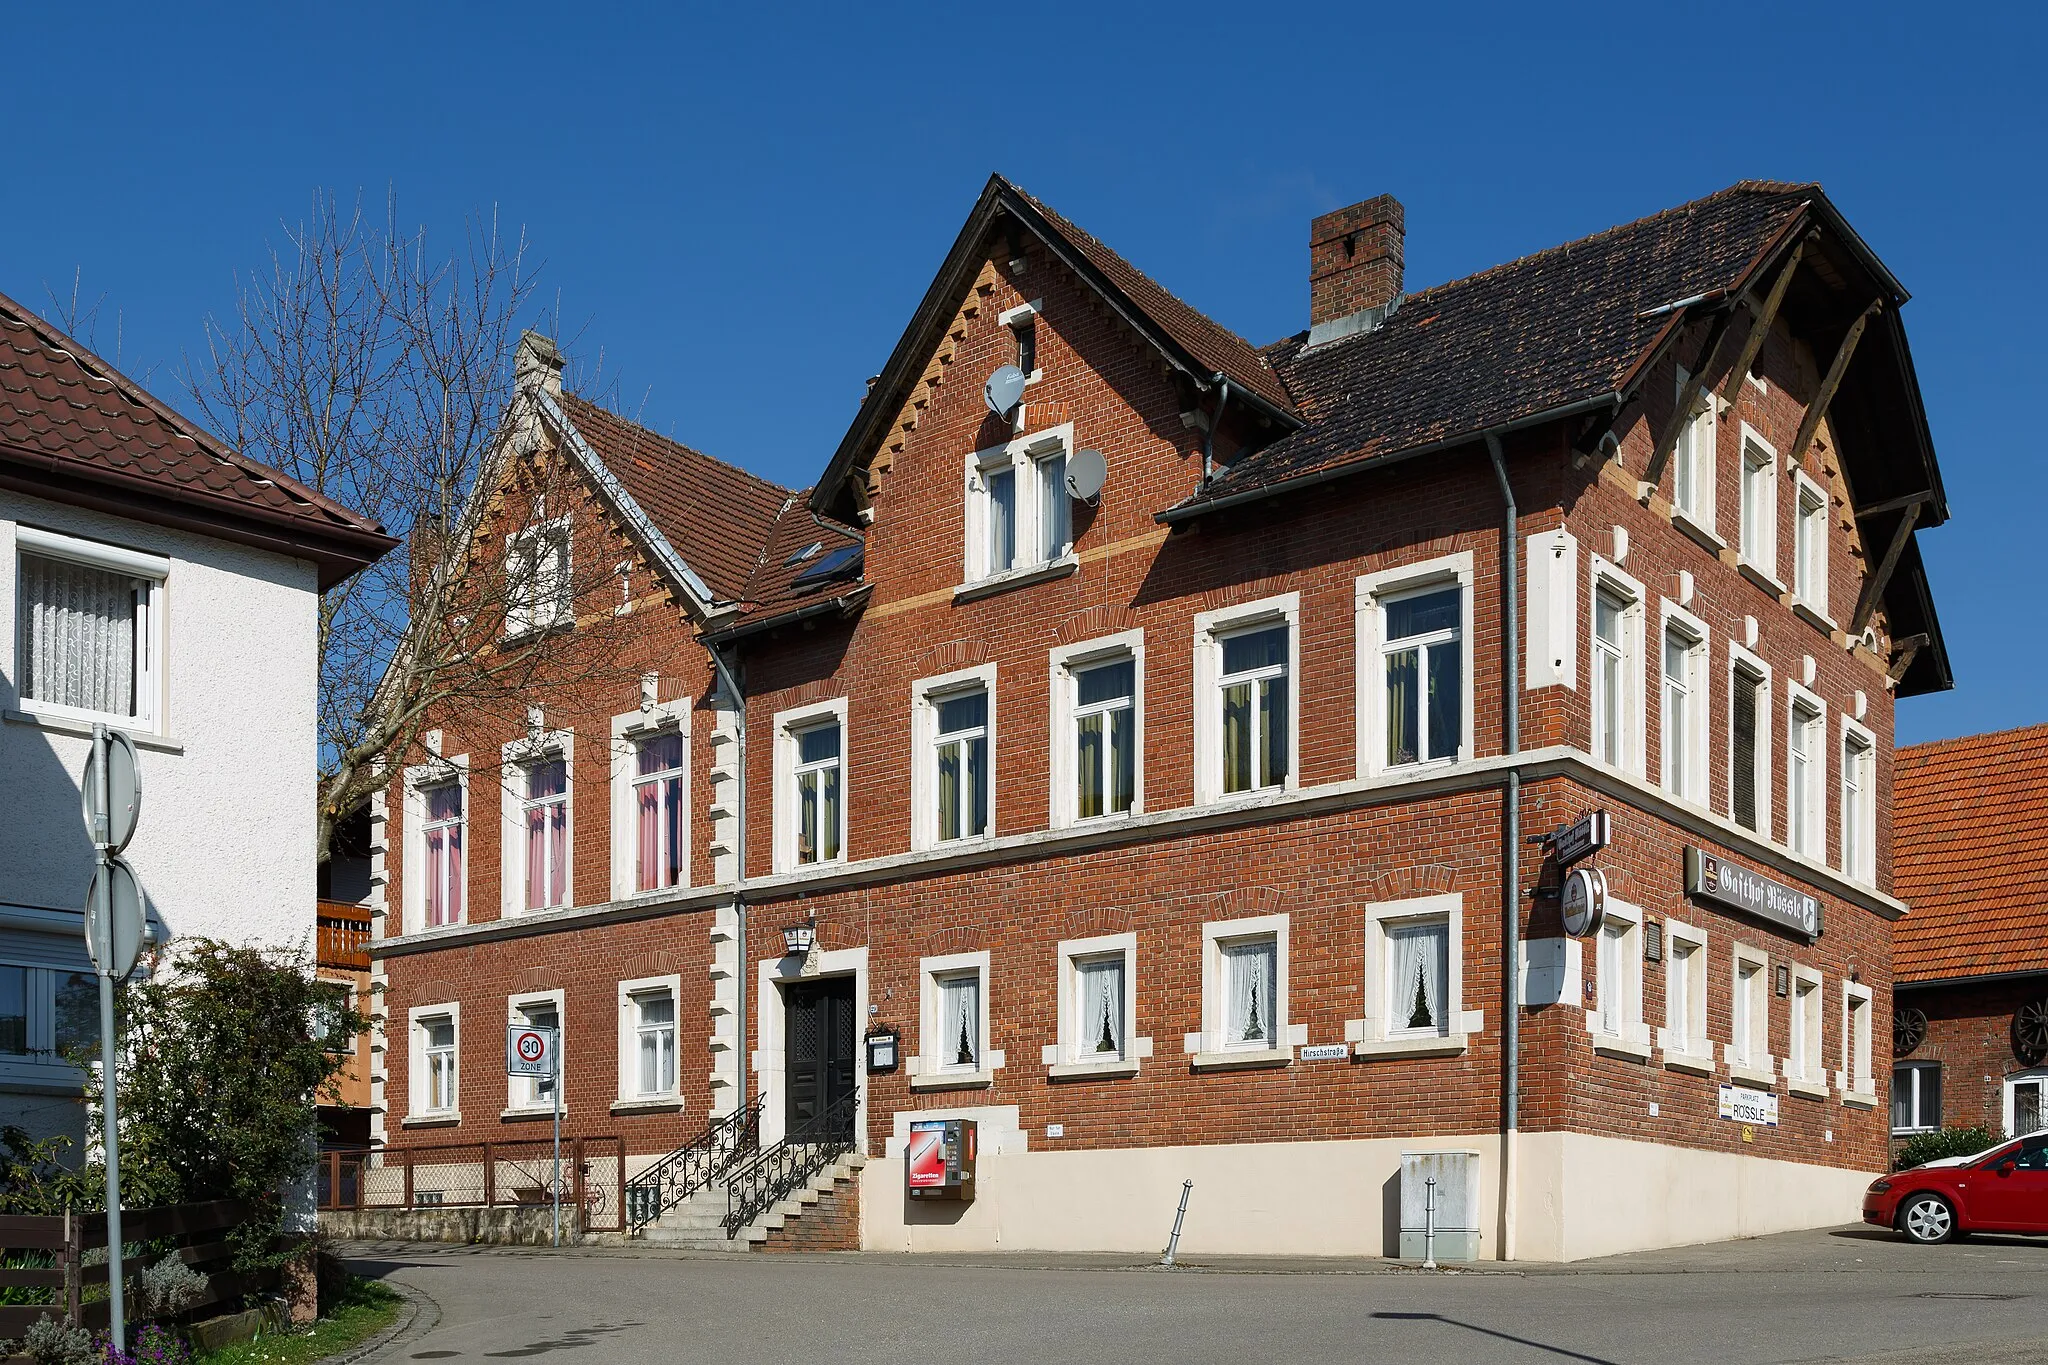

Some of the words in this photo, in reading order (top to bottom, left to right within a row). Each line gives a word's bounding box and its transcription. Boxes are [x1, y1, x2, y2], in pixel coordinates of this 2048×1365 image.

[1766, 884, 1801, 919] Rössle
[523, 1041, 539, 1054] 30
[1303, 1047, 1344, 1057] Hirschstraße
[520, 1063, 541, 1071] ZONE
[1733, 1104, 1765, 1121] RÖSSLE
